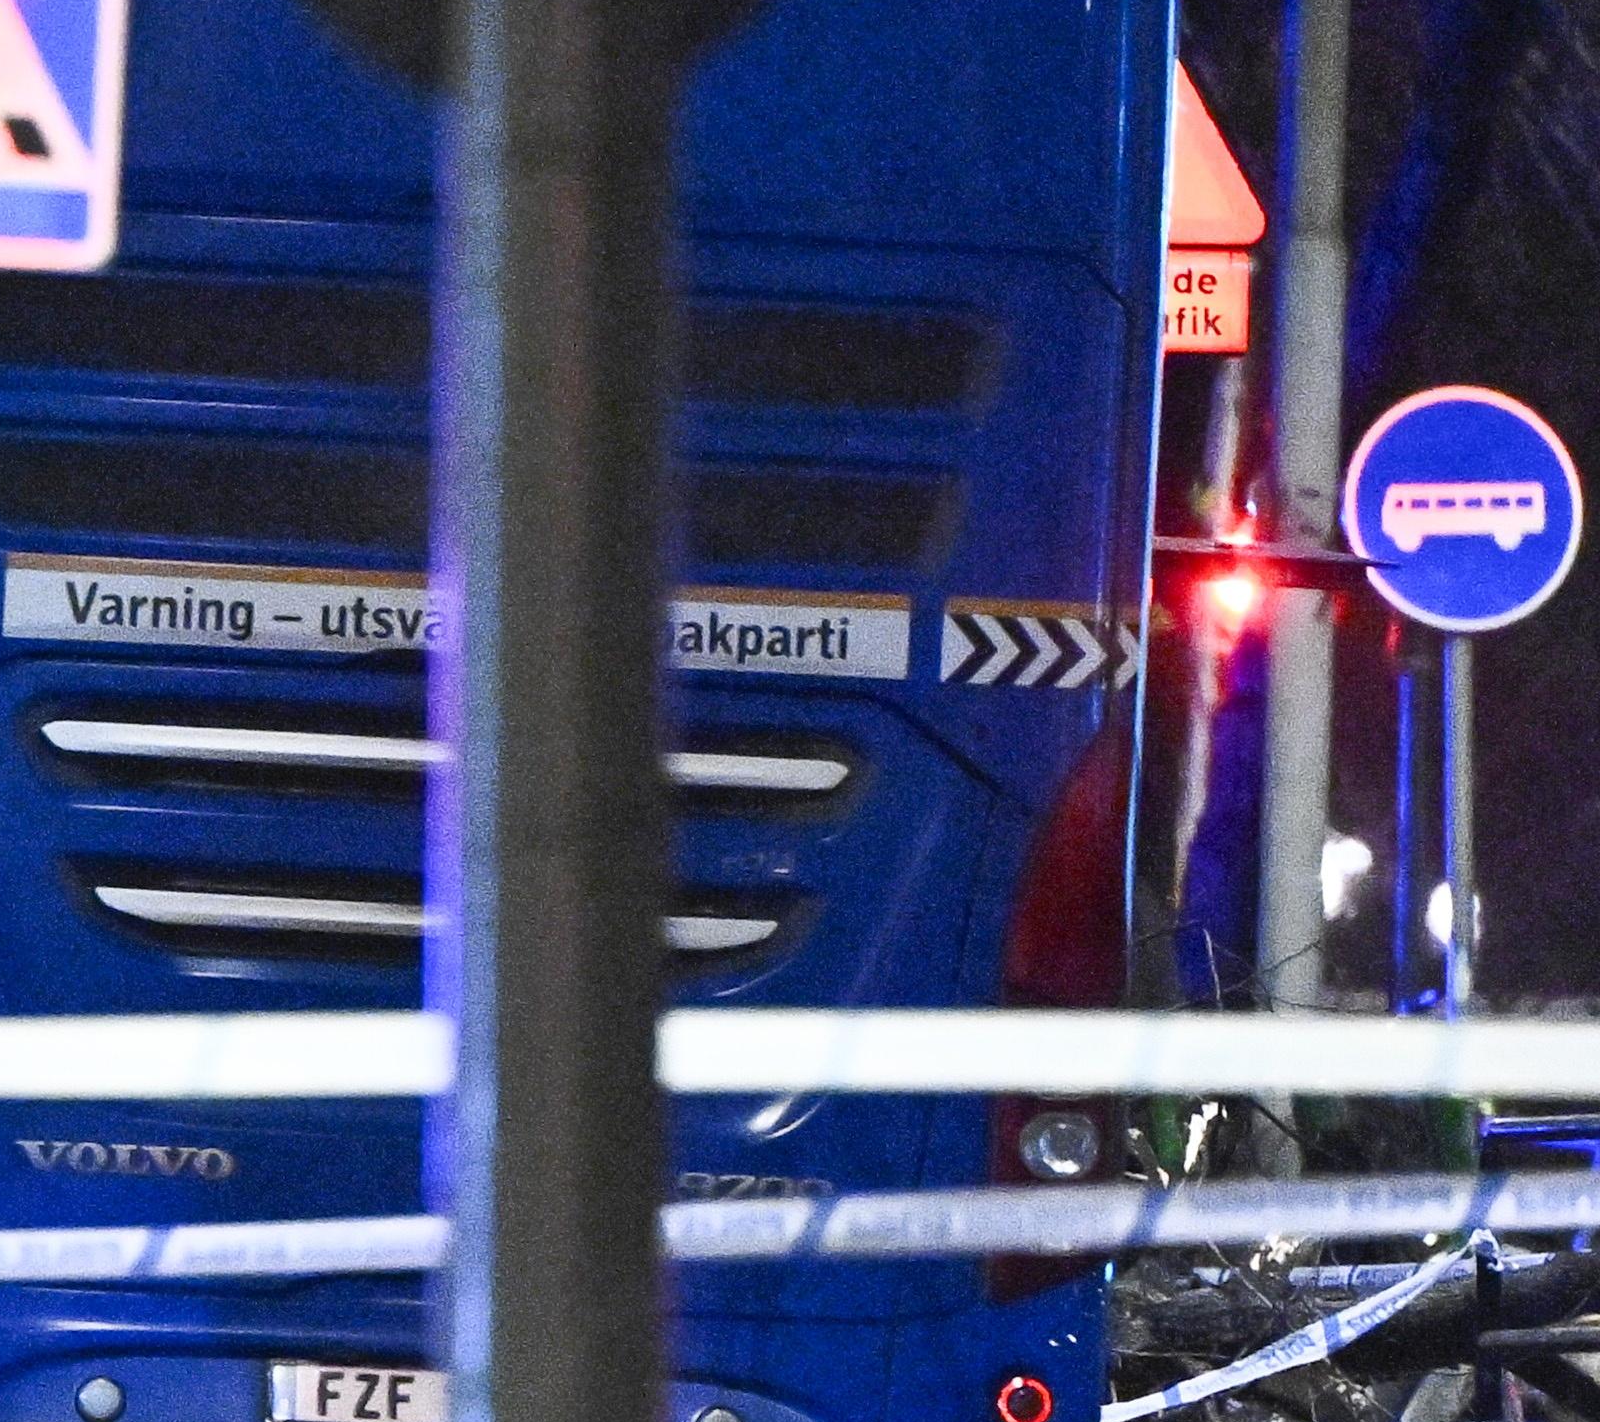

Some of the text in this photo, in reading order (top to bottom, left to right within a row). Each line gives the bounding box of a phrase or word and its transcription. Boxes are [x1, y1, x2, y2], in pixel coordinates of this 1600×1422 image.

[1173, 267, 1218, 295] de
[65, 580, 254, 641] Varning
[668, 611, 850, 665] akparti
[15, 1139, 236, 1180] VOLVO
[316, 1370, 416, 1420] FZF
